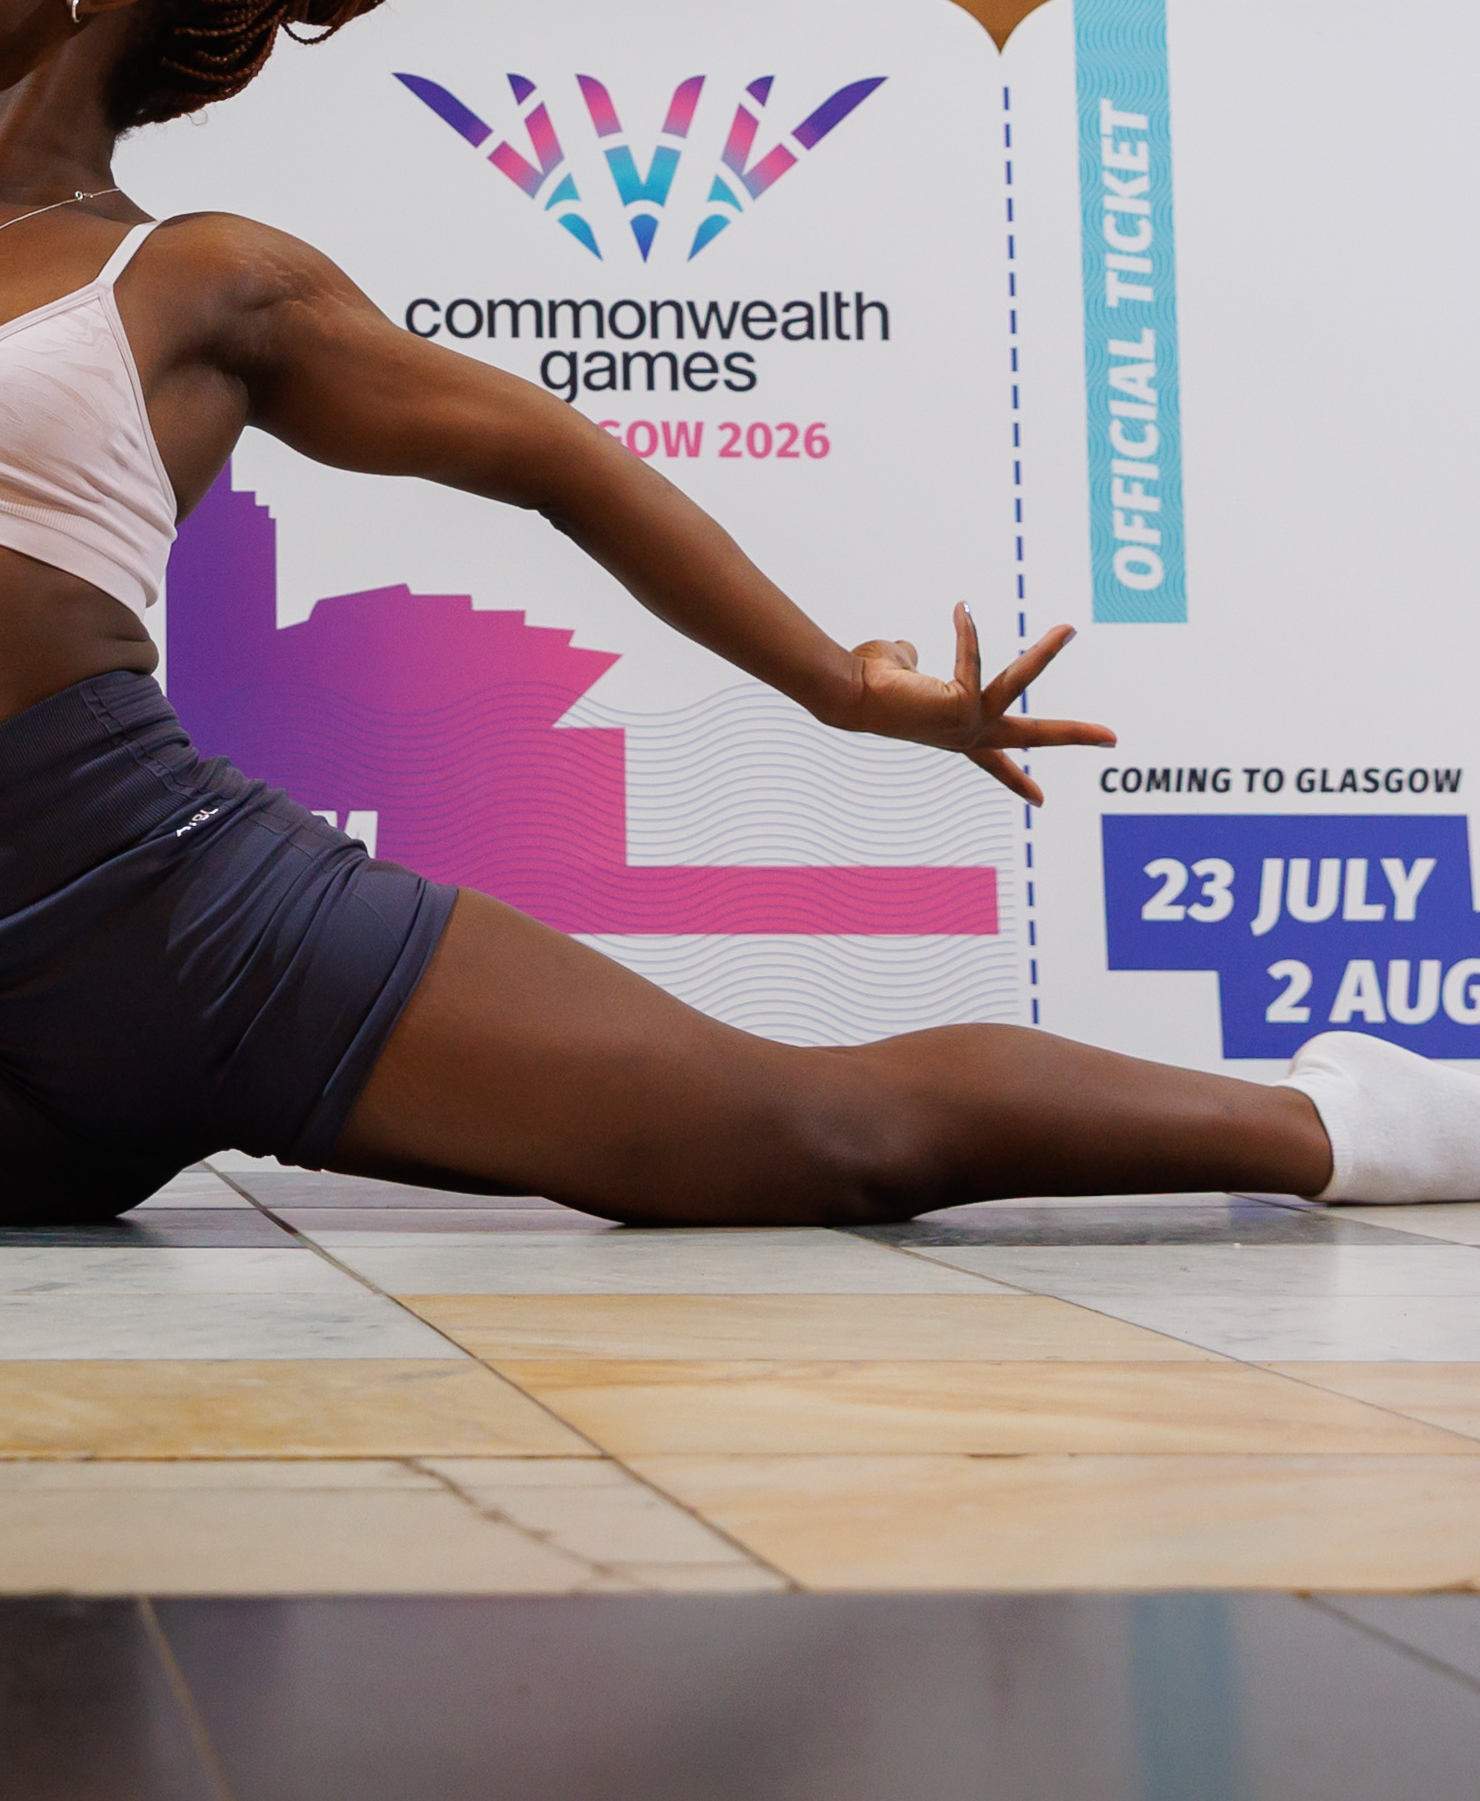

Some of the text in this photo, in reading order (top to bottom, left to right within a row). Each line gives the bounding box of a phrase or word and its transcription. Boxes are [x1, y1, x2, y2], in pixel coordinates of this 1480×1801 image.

[404, 291, 889, 341] commonwealth
[1100, 97, 1164, 590] OFFICIAL TICKET
[539, 350, 758, 404] games
[717, 421, 832, 459] 2026
[1099, 766, 1463, 795] COMING TO GLASGOW
[1142, 857, 1437, 936] 23 JULY
[1265, 958, 1313, 1024] 2
